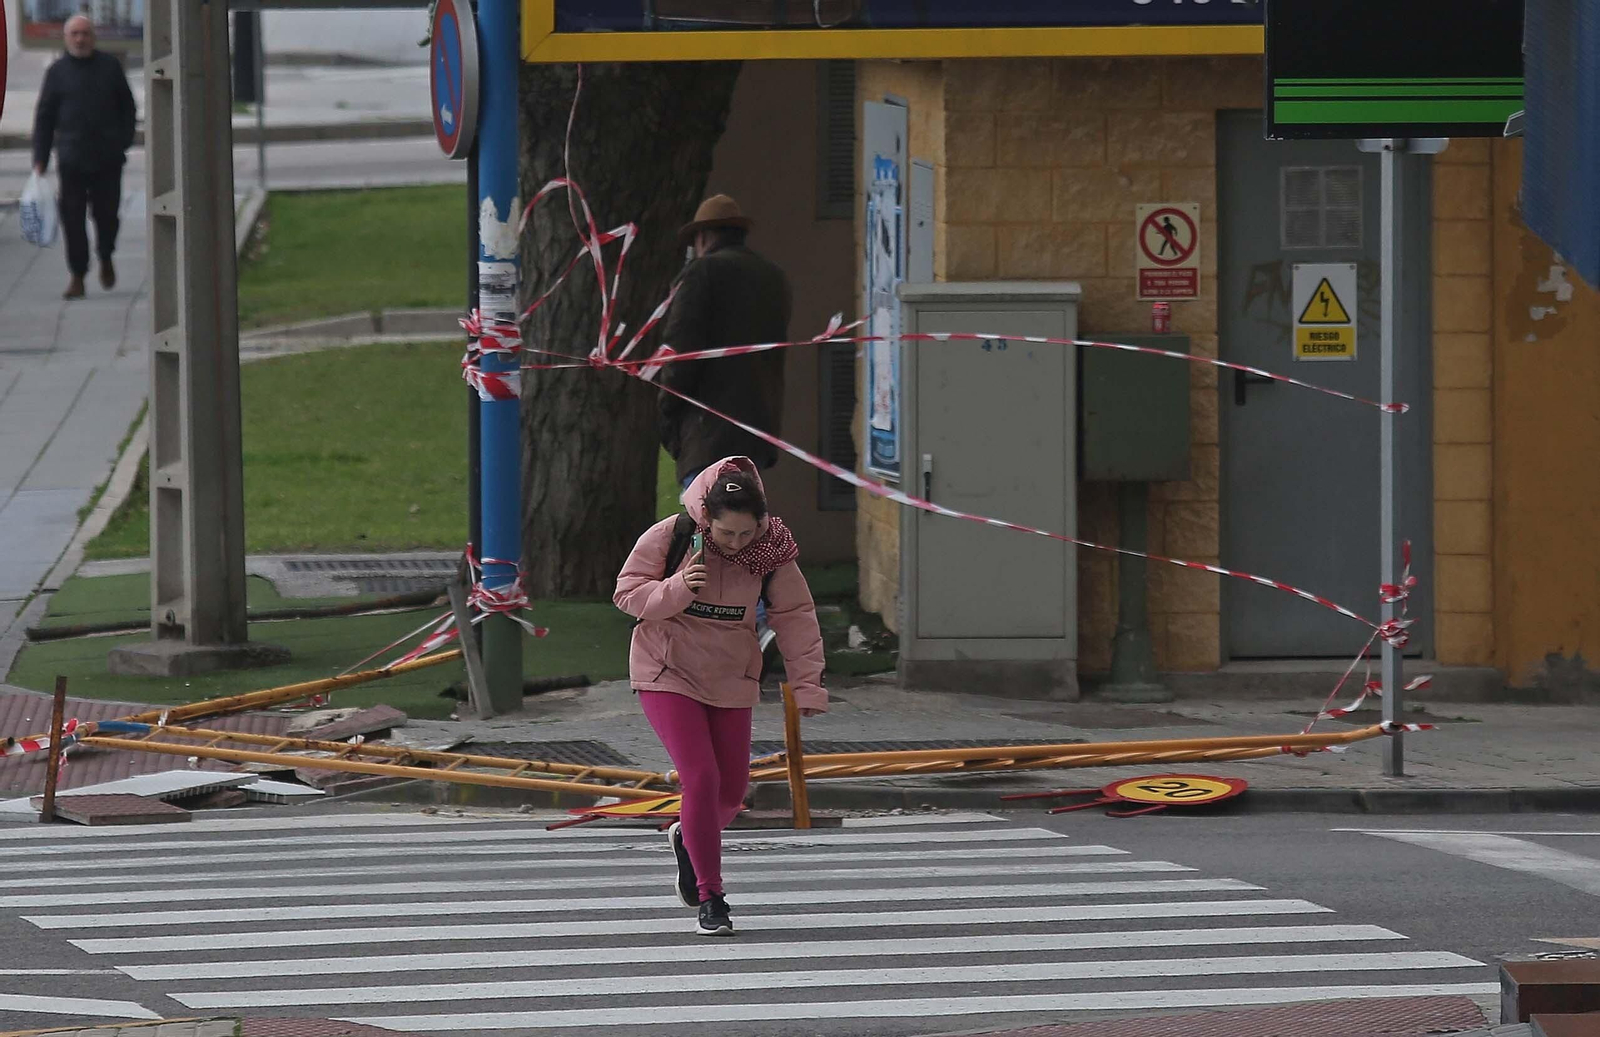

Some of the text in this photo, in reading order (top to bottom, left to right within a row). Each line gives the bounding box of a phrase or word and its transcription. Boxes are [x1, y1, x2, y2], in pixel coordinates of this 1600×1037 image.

[1309, 332, 1340, 341] RIESGO
[1302, 343, 1347, 353] ELÉCTRICO
[713, 606, 745, 616] REPUBLIC
[1137, 781, 1213, 798] 20
